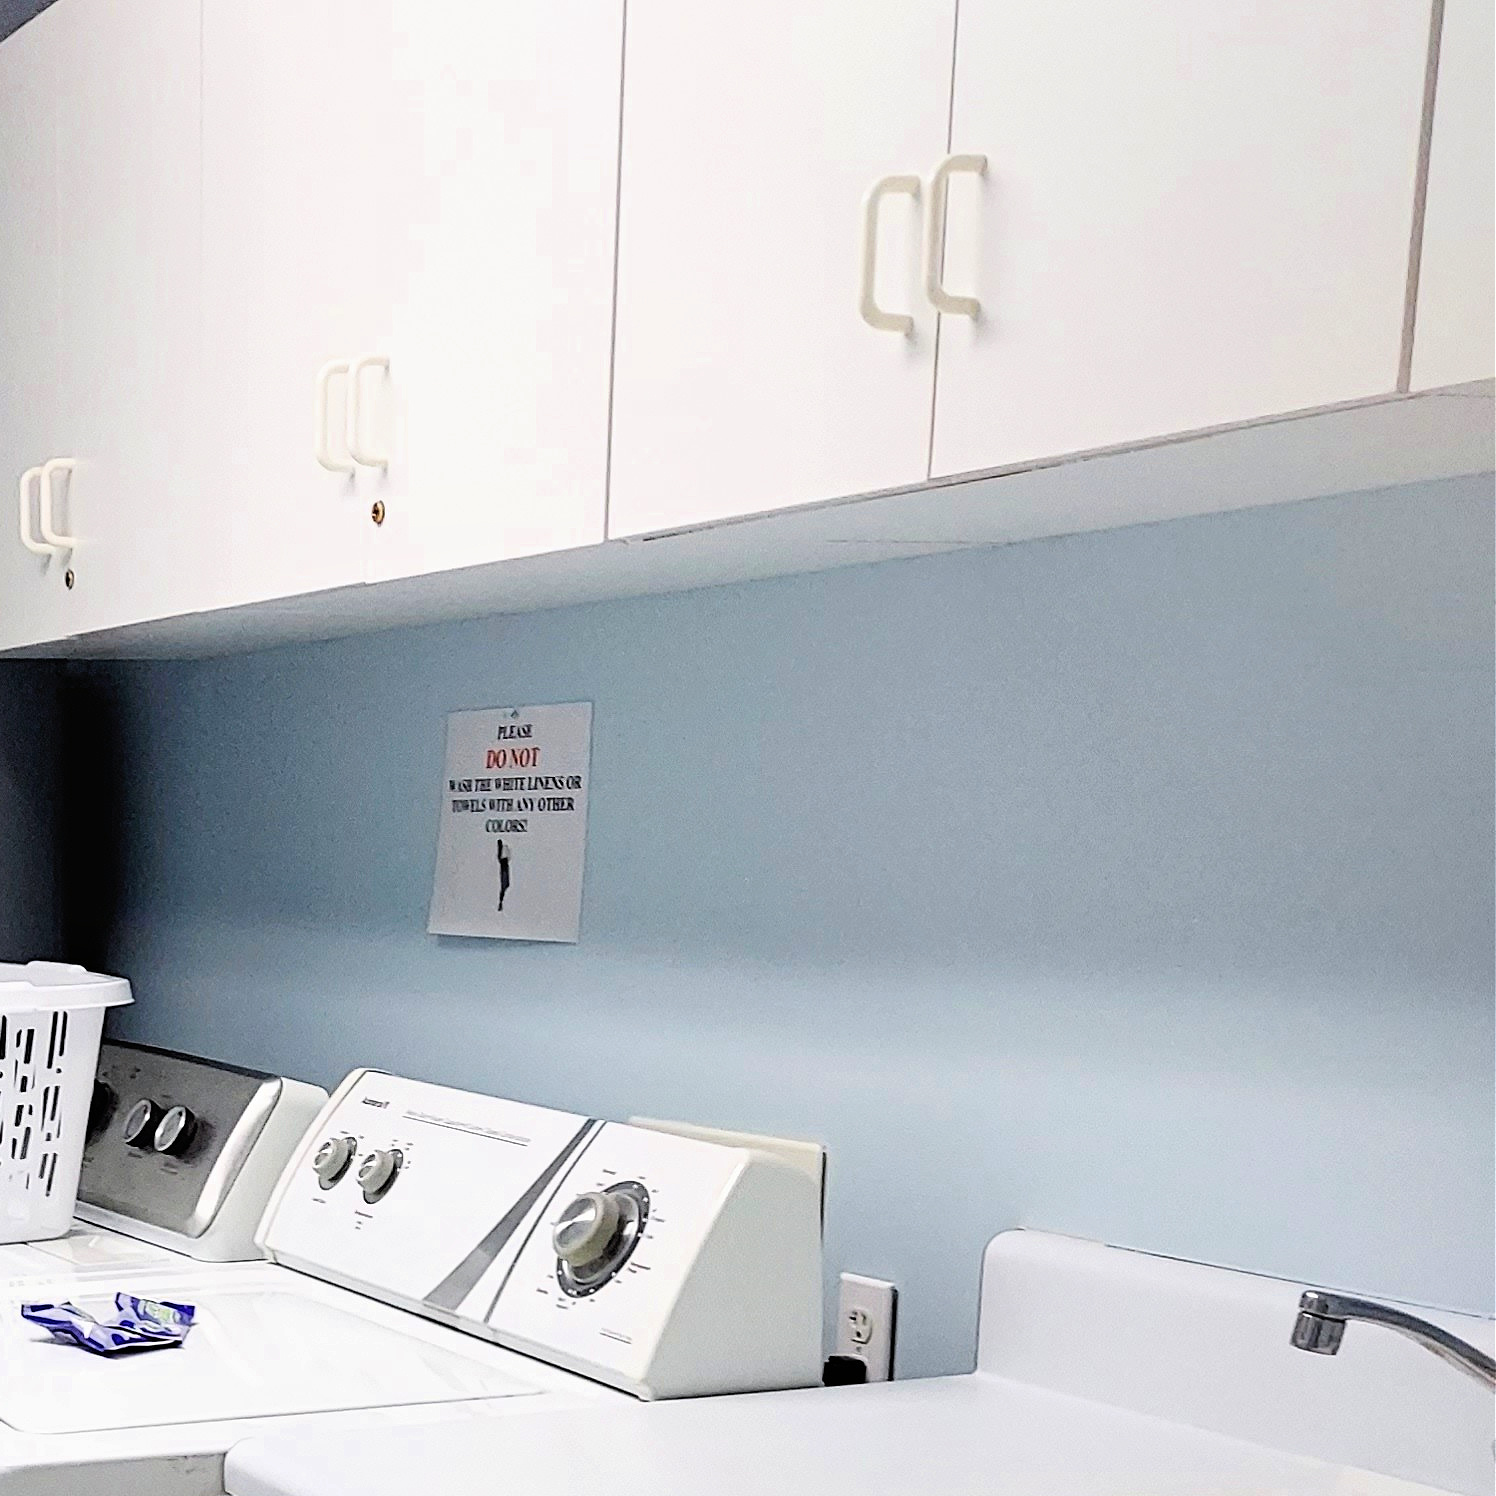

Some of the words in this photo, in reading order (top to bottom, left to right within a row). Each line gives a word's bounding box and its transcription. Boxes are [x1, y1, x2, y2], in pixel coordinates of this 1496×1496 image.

[498, 724, 533, 740] PLEASE
[486, 749, 507, 769] DO
[510, 747, 541, 768] NOT
[448, 779, 472, 792] WASH
[474, 778, 492, 792] THE
[494, 777, 526, 791] WHITE
[527, 776, 565, 790] LINENS
[566, 775, 582, 789] OR
[452, 799, 486, 813] TOWELS
[489, 798, 514, 812] WITH
[517, 797, 535, 811] ANY
[537, 797, 575, 811] OTHER
